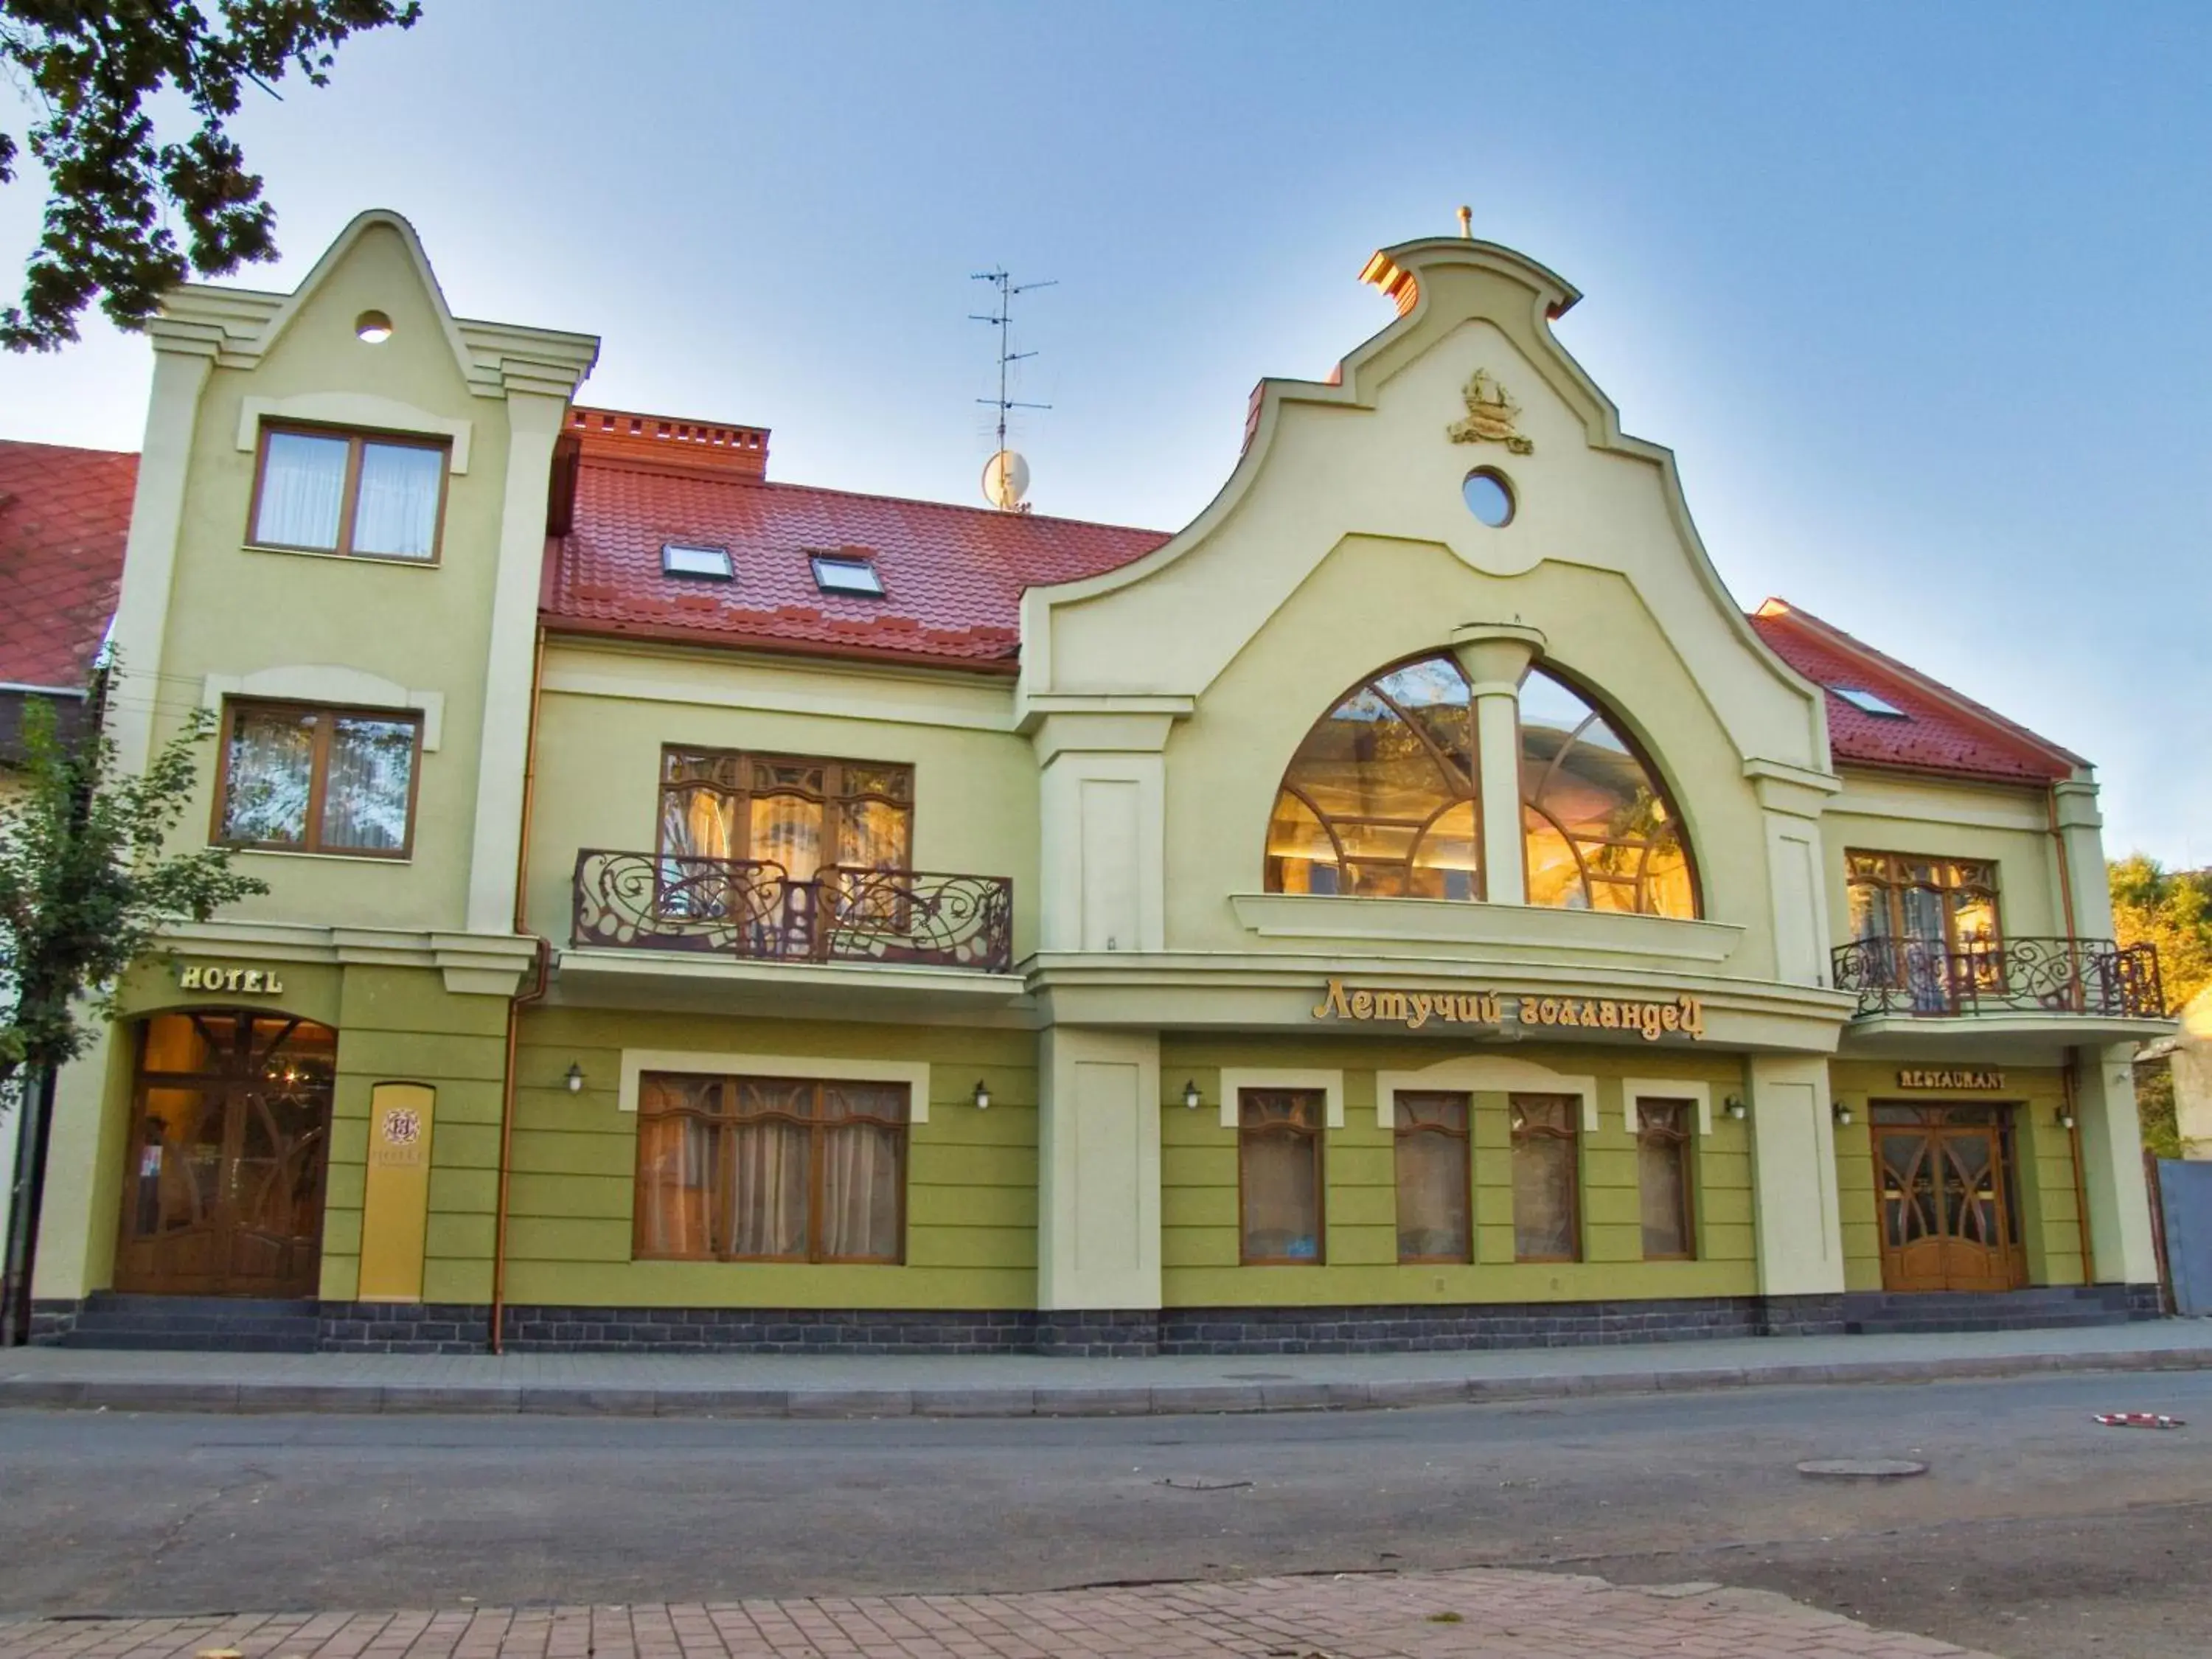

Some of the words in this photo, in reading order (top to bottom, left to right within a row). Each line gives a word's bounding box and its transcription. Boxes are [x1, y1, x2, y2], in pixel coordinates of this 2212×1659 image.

[180, 966, 283, 993] HOTEL
[1313, 978, 1500, 1028] Летучий
[1901, 1071, 2006, 1088] RESTAURANT
